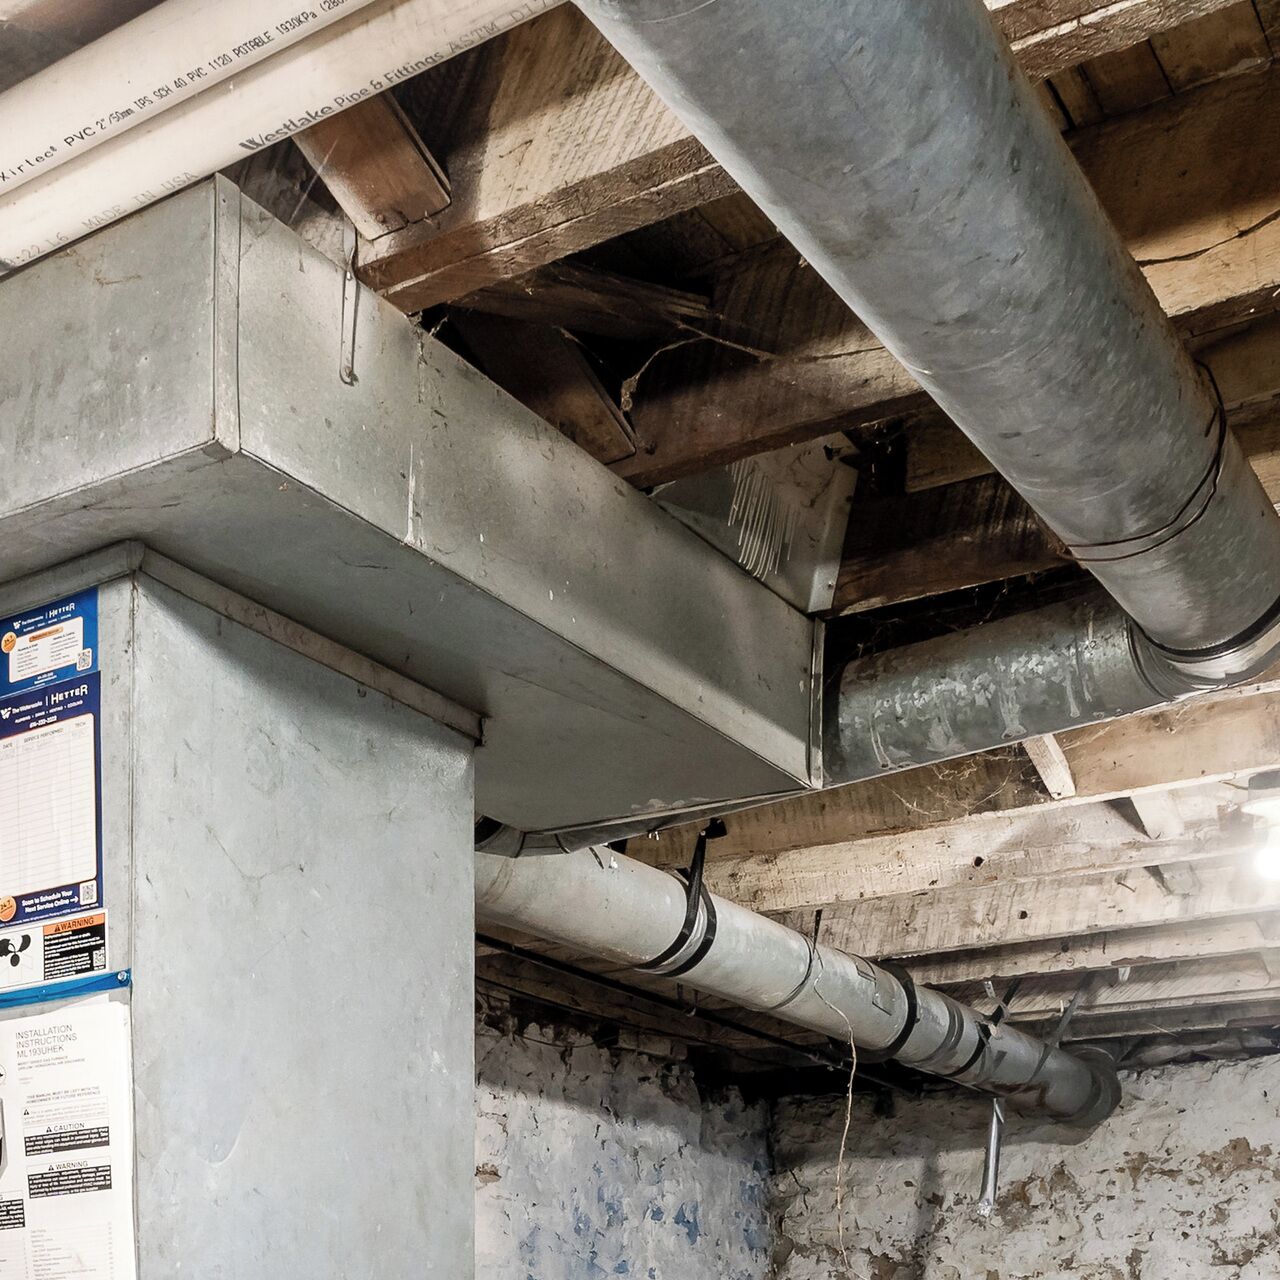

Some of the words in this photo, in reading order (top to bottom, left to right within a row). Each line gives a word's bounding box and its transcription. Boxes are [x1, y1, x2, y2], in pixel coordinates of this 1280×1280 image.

[63, 126, 96, 147] PVC
[134, 96, 153, 111] IPS
[153, 85, 173, 100] SCH
[173, 77, 188, 90] 40
[186, 67, 208, 83] PVC
[208, 53, 232, 72] 1120
[232, 31, 274, 58] POTABLE
[275, 10, 318, 36] 1930KPa
[239, 104, 335, 151] Westlake
[334, 85, 370, 108] Pipe
[373, 79, 383, 91] &
[384, 52, 445, 85] Fittings
[447, 22, 500, 53] ASTM
[81, 205, 128, 230] MADE
[133, 191, 157, 207] IN
[160, 171, 199, 192] USA
[51, 684, 88, 705] HETTER
[22, 898, 35, 907] Scan
[39, 892, 62, 904] Schedule
[25, 905, 36, 913] Next
[36, 902, 54, 912] Service
[60, 916, 95, 930] WARNING
[15, 1024, 73, 1040] INSTALLATION
[16, 1033, 78, 1049] INSTRUCTIONS
[16, 1045, 66, 1059] ML193UHEK
[53, 1122, 86, 1132] CAUTION
[55, 1161, 89, 1171] WARNING
